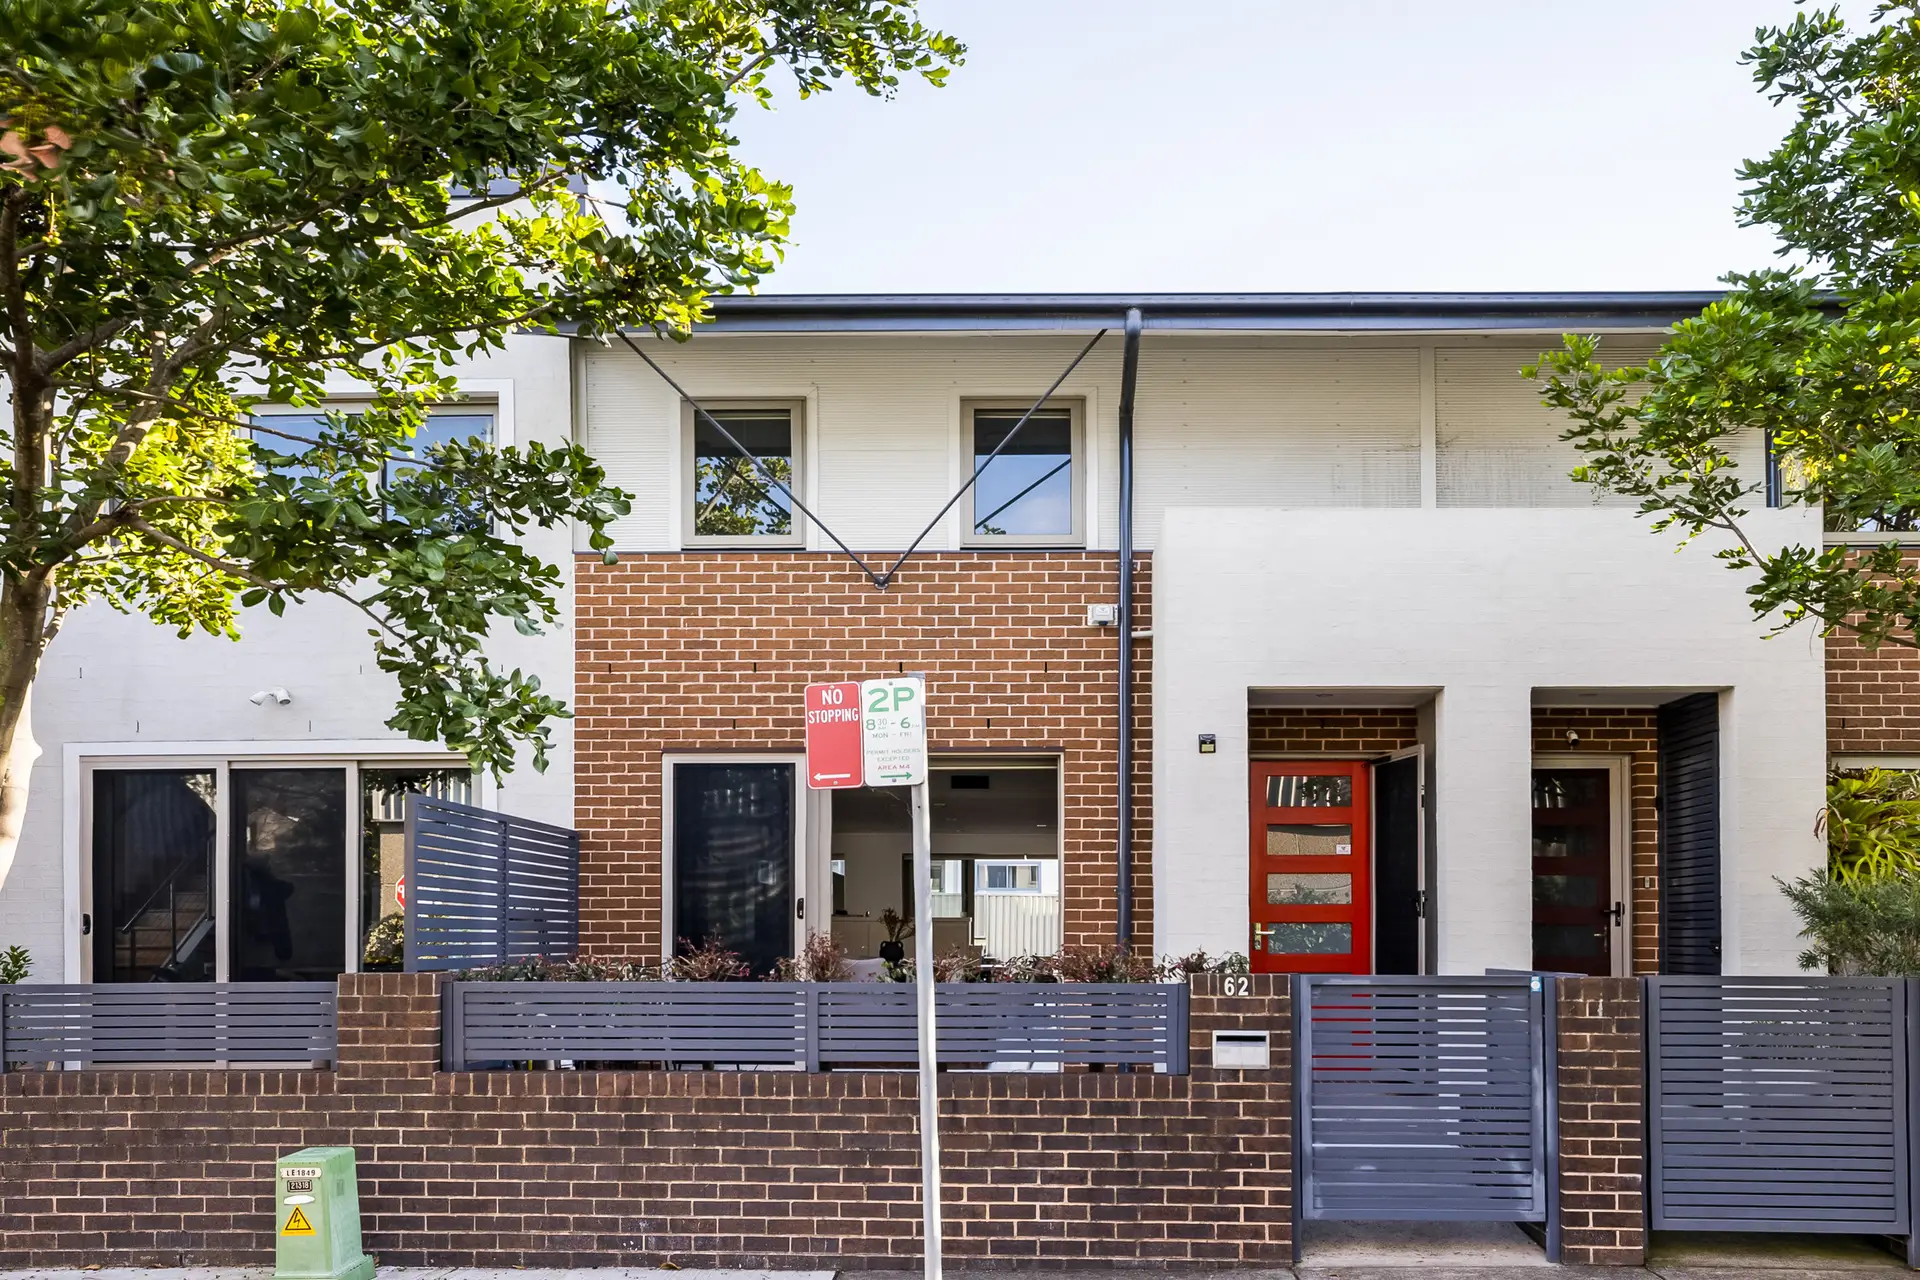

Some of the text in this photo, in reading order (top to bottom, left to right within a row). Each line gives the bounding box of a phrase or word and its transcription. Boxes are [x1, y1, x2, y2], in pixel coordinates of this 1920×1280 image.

[821, 689, 843, 705] NO
[868, 686, 915, 713] 2P
[808, 708, 859, 724] STOPPING
[1224, 977, 1249, 996] 62
